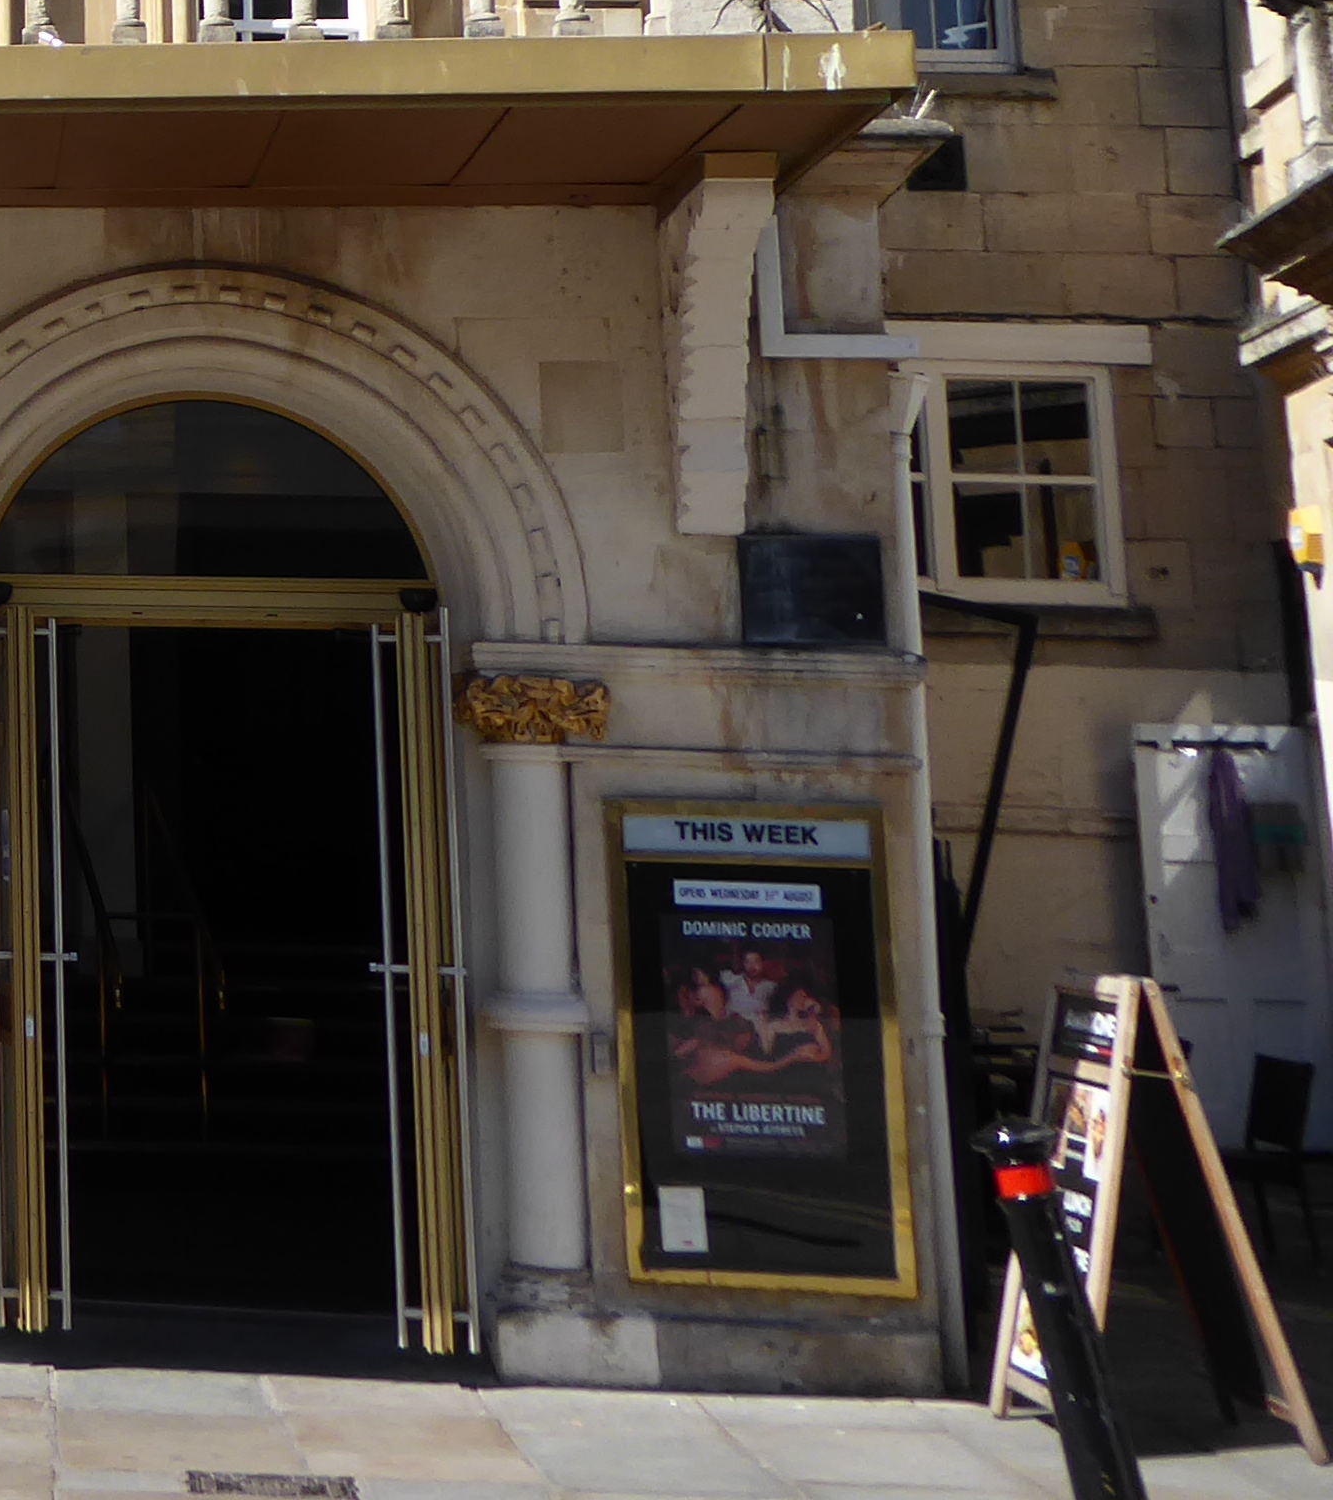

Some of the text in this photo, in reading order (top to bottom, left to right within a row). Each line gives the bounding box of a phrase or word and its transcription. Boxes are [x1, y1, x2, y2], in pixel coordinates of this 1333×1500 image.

[674, 820, 819, 846] THIS WEEK
[682, 920, 812, 939] DOMINIC COOPER
[691, 1101, 826, 1125] THE LIBERTINE
